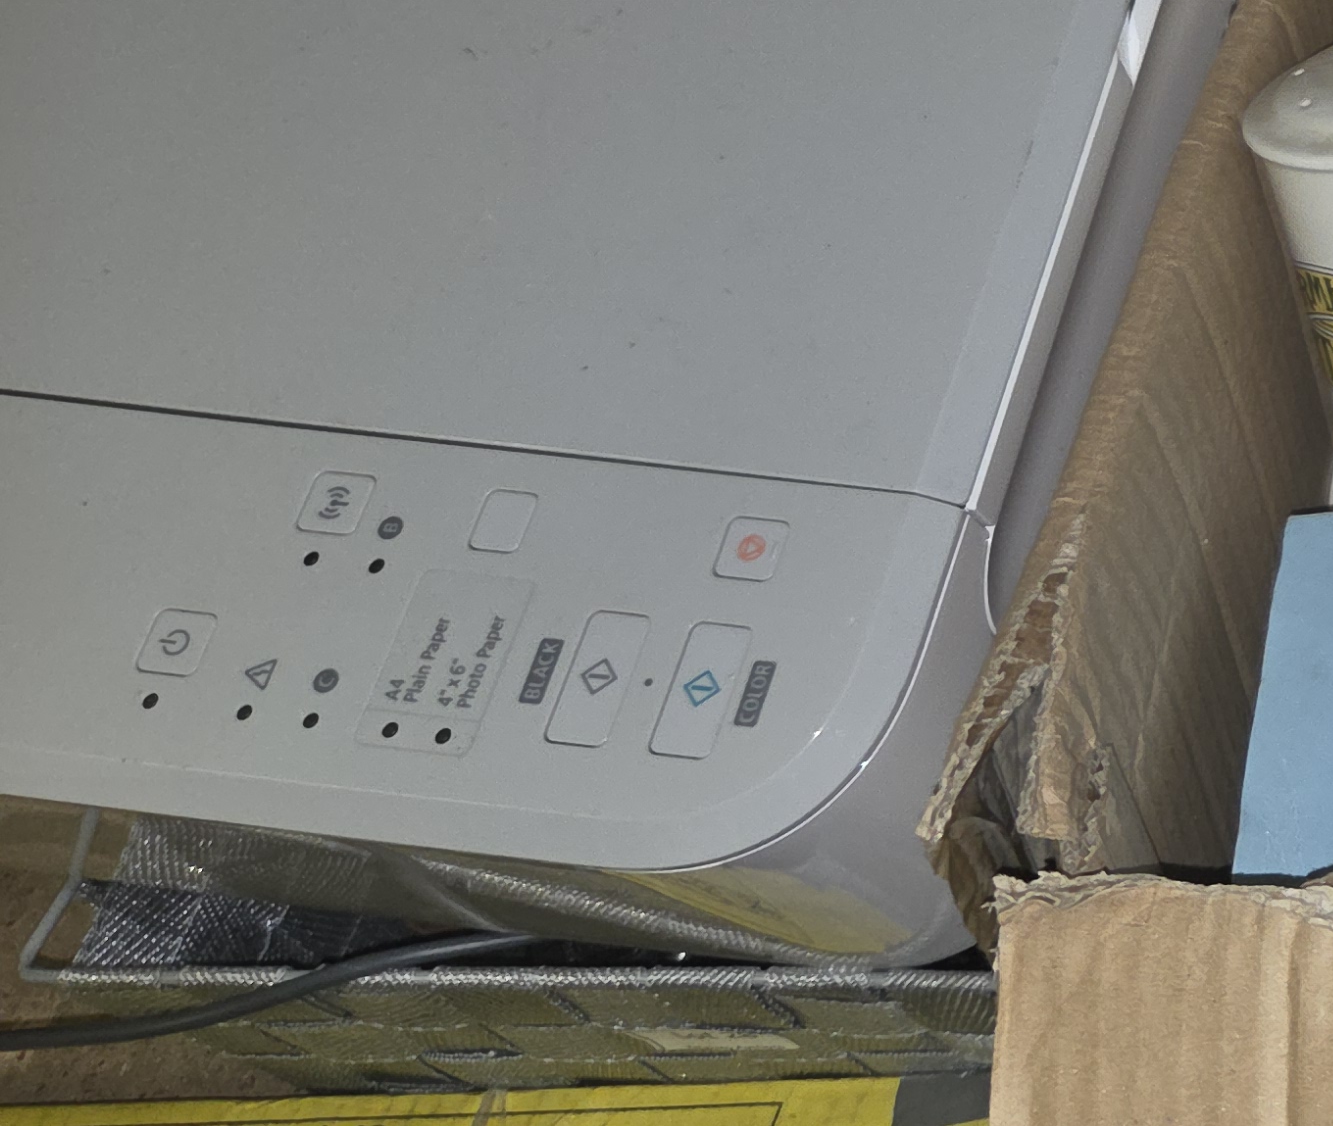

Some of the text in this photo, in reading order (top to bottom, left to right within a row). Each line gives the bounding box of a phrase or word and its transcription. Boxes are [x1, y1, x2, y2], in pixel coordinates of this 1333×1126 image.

[384, 678, 406, 702] A4
[403, 617, 451, 703] Plain Paper
[456, 615, 506, 709] Photo Paper
[523, 642, 561, 700] BLACK
[738, 665, 773, 725] COLOR
